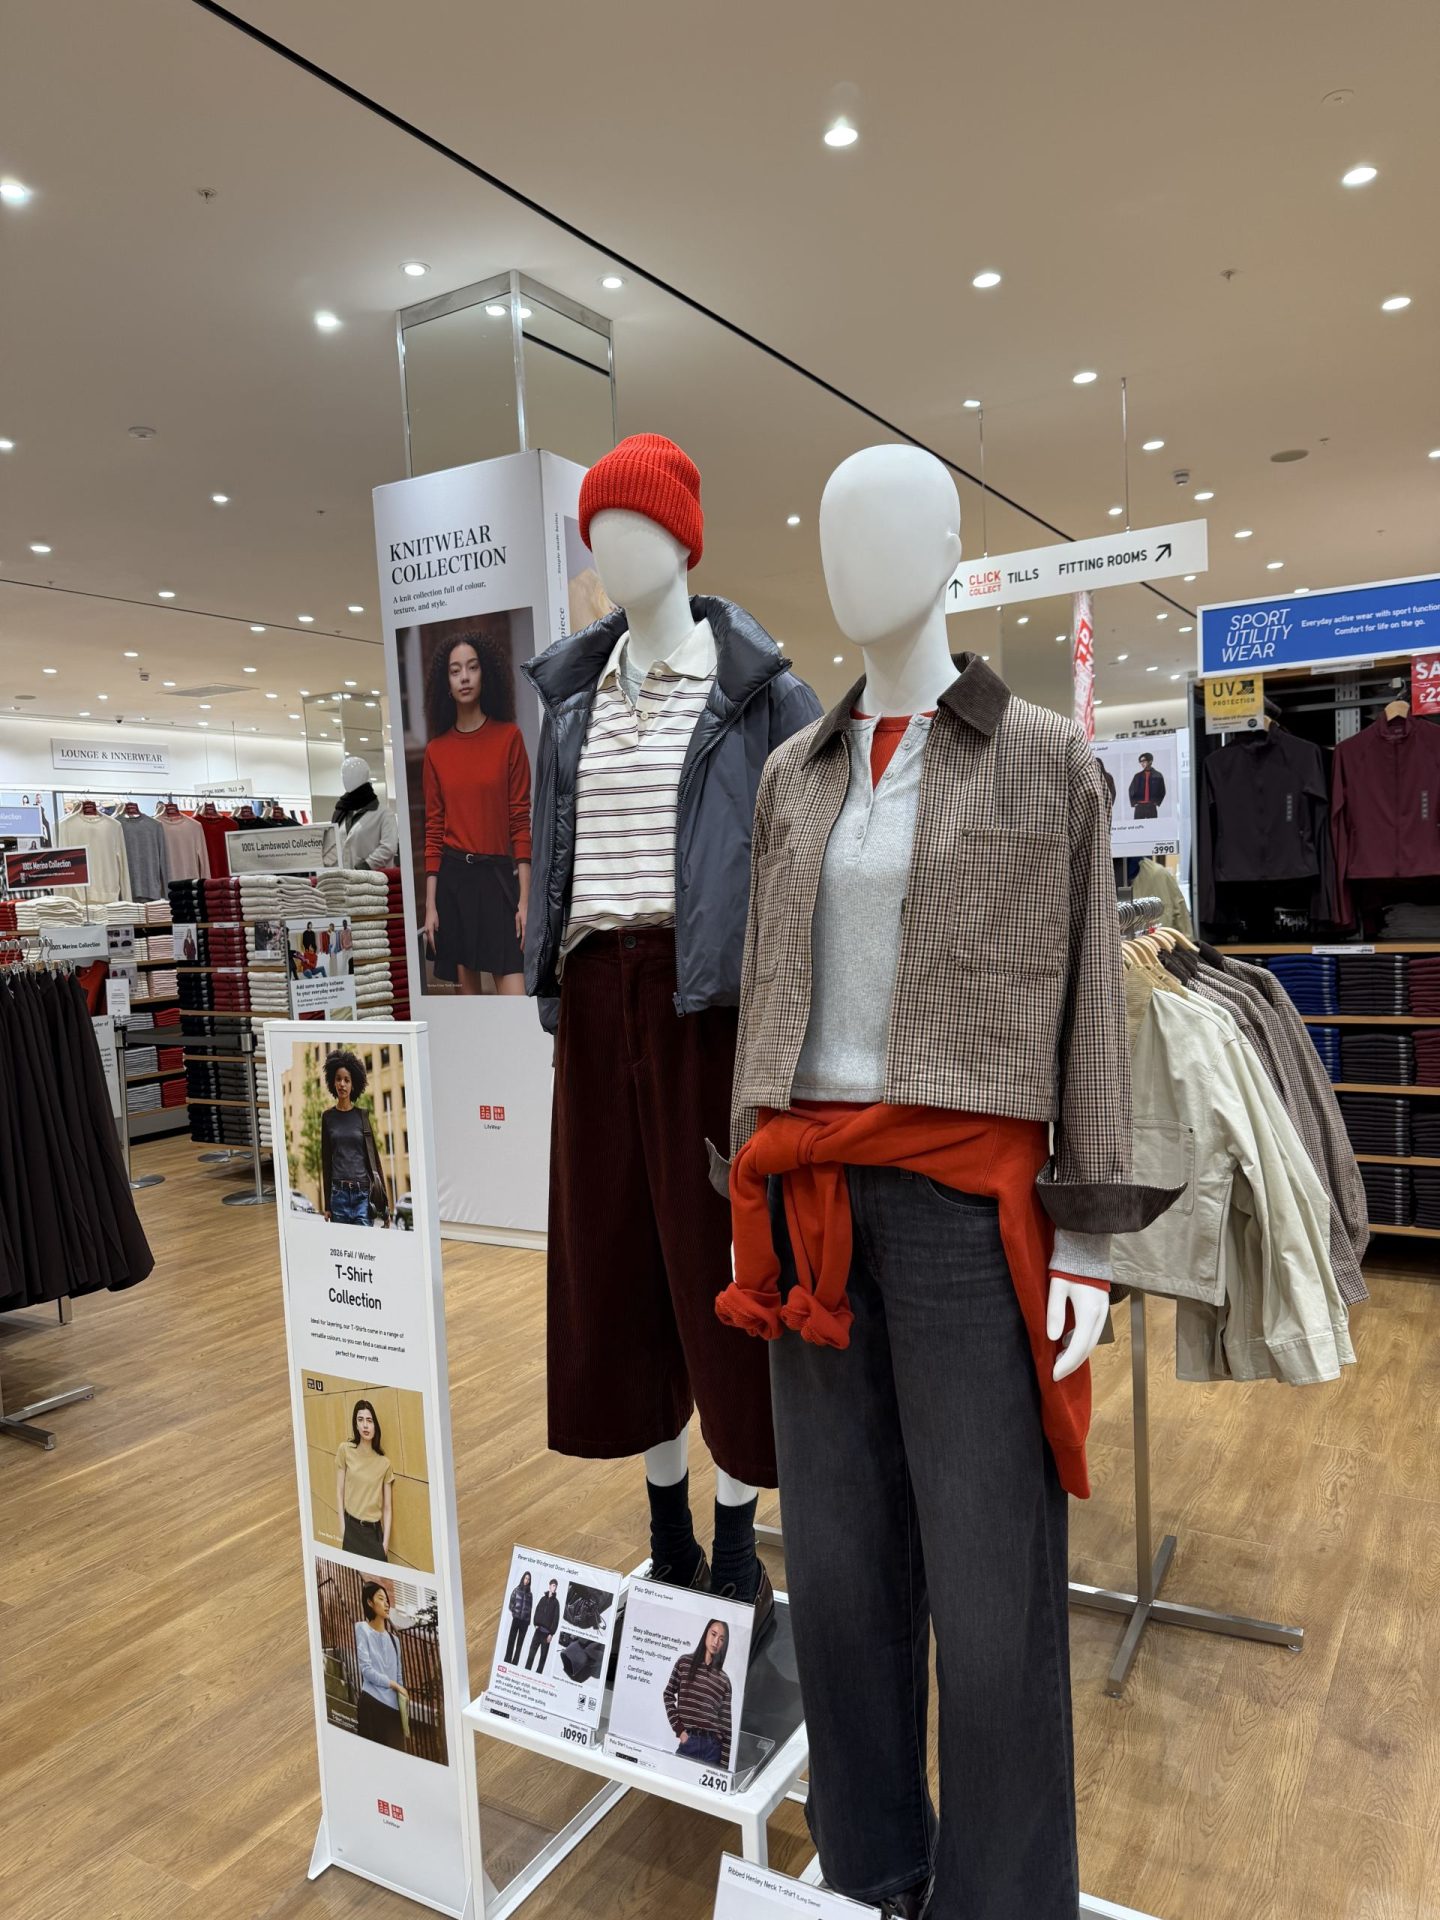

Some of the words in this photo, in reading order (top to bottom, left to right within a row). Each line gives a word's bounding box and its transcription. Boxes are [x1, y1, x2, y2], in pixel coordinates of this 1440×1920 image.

[390, 524, 492, 562] KNITWEAR
[391, 546, 506, 585] COLLECTION
[969, 570, 1000, 585] CLICK
[1008, 568, 1039, 584] TILLS
[1059, 557, 1104, 575] FITTING
[1108, 550, 1147, 567] ROOMS
[400, 594, 411, 603] knit
[413, 588, 442, 600] collection
[444, 586, 454, 595] full
[457, 584, 463, 592] of
[969, 584, 1001, 597] COLLECT
[418, 602, 429, 610] and
[431, 600, 447, 610] style.
[1230, 608, 1291, 630] SPORT
[1301, 617, 1332, 628] Everyday
[1334, 615, 1354, 624] active
[1356, 612, 1373, 621] wear
[1375, 609, 1391, 619] with
[1392, 606, 1411, 617] sport
[1226, 624, 1293, 647] UTILITY
[1334, 626, 1363, 636] Comfort
[1365, 624, 1376, 632] for
[1377, 622, 1389, 630] life
[1401, 619, 1413, 627] the
[1414, 618, 1425, 627] go.
[1222, 643, 1275, 662] WEAR
[1416, 661, 1440, 680] SA
[1213, 681, 1235, 697] UV
[1133, 719, 1158, 729] TILLS
[1160, 718, 1167, 726] &
[61, 749, 99, 759] LOUNGE
[101, 752, 108, 760] &
[111, 752, 163, 763] INNERWEAR
[242, 842, 255, 852] 100%
[256, 840, 291, 851] Lambswool
[292, 838, 323, 849] Collection
[33, 861, 48, 870] Merino
[48, 860, 72, 869] Collection
[344, 1250, 353, 1258] Fall
[358, 1251, 376, 1261] Winter
[335, 1264, 373, 1284] T-Shirt
[328, 1287, 382, 1310] Collection
[634, 1585, 644, 1593] Polo
[632, 1635, 643, 1643] many
[644, 1638, 662, 1646] different
[633, 1626, 643, 1634] Boxy
[644, 1629, 662, 1639] silhouette
[631, 1645, 644, 1655] Trendy
[628, 1664, 653, 1676] Comfortable
[728, 1866, 745, 1879] Ribbed
[746, 1872, 763, 1887] Henley
[764, 1880, 777, 1890] Neck
[778, 1886, 796, 1898] T-shirt
